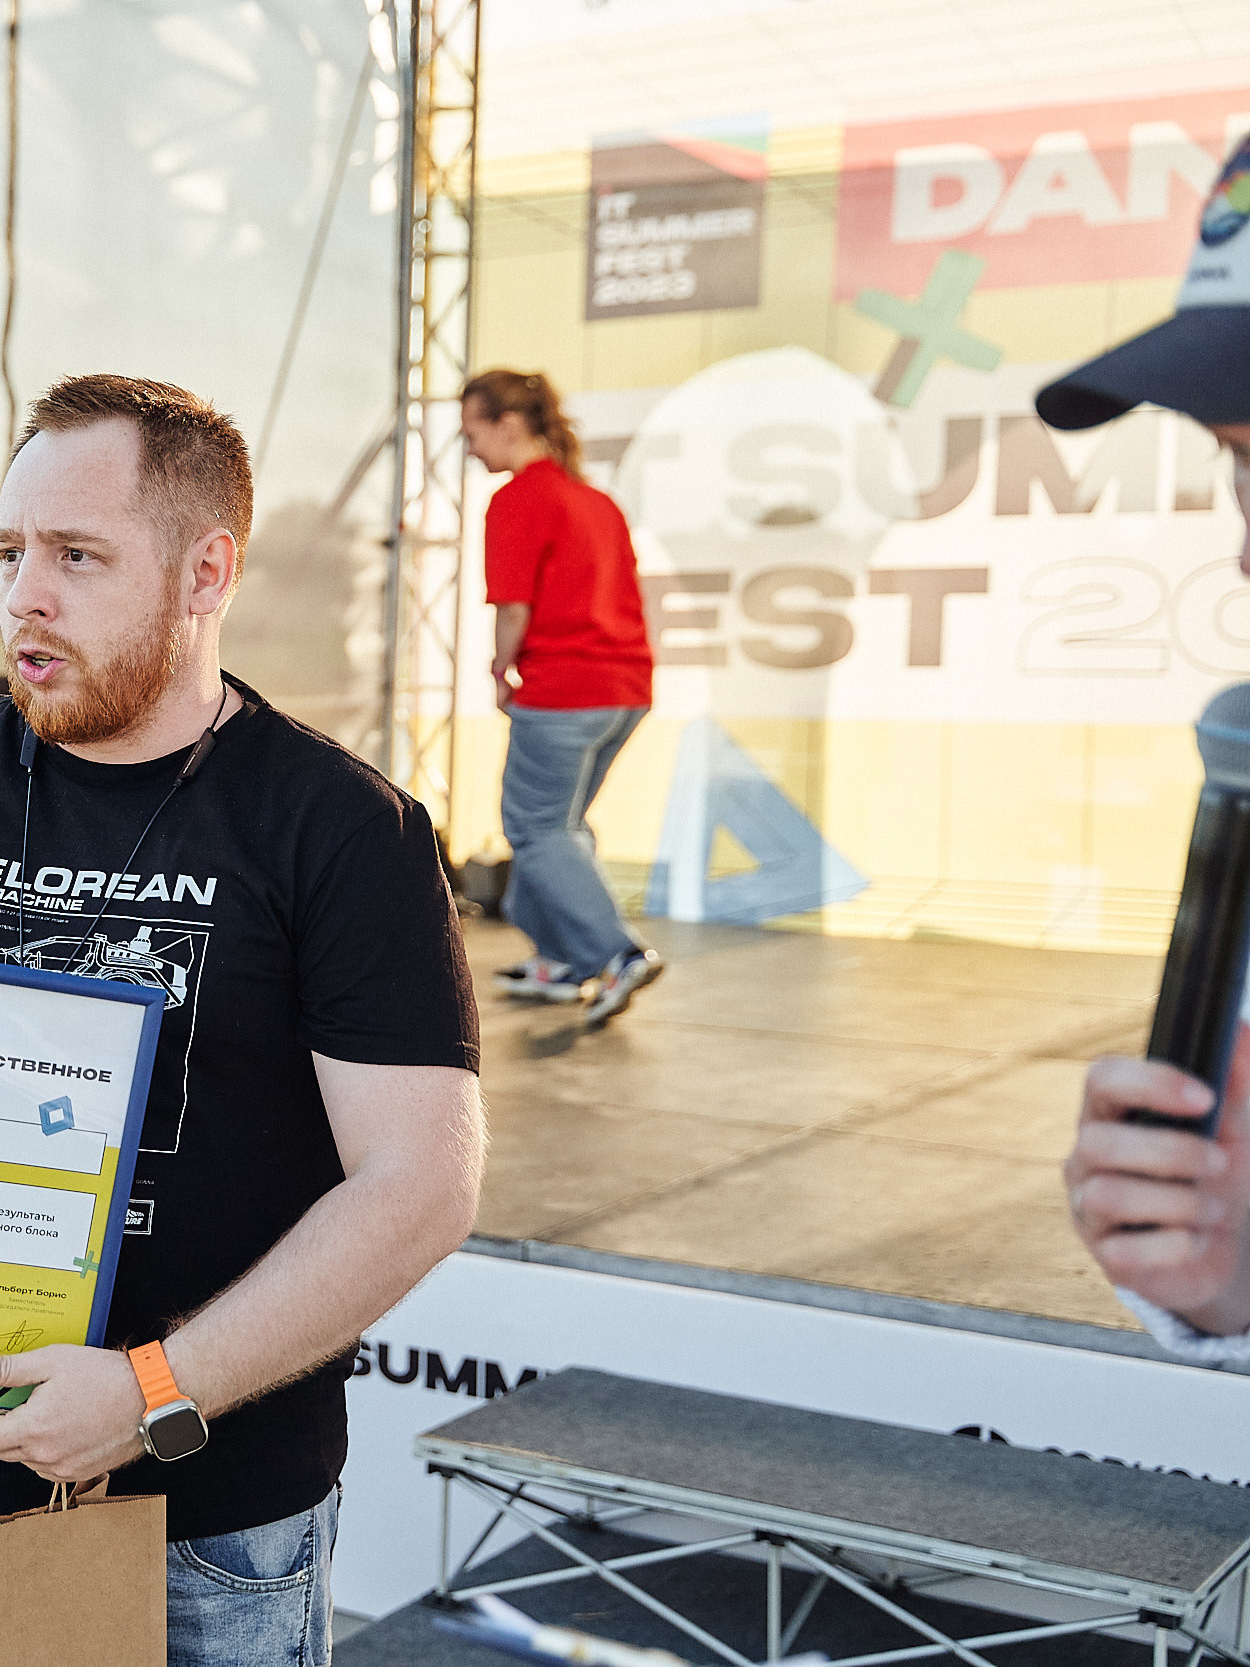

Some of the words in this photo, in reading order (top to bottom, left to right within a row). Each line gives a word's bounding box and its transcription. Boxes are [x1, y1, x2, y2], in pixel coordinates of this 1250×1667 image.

[891, 112, 1250, 243] DAN
[596, 191, 638, 222] IT
[595, 207, 756, 249] SUMMER
[594, 244, 691, 277] FEST
[592, 268, 697, 307] 2023
[726, 414, 1235, 527] SUM
[640, 566, 990, 671] EST
[25, 1224, 59, 1239] блока
[36, 1289, 67, 1299] Борис
[353, 1340, 550, 1399] SUMM
